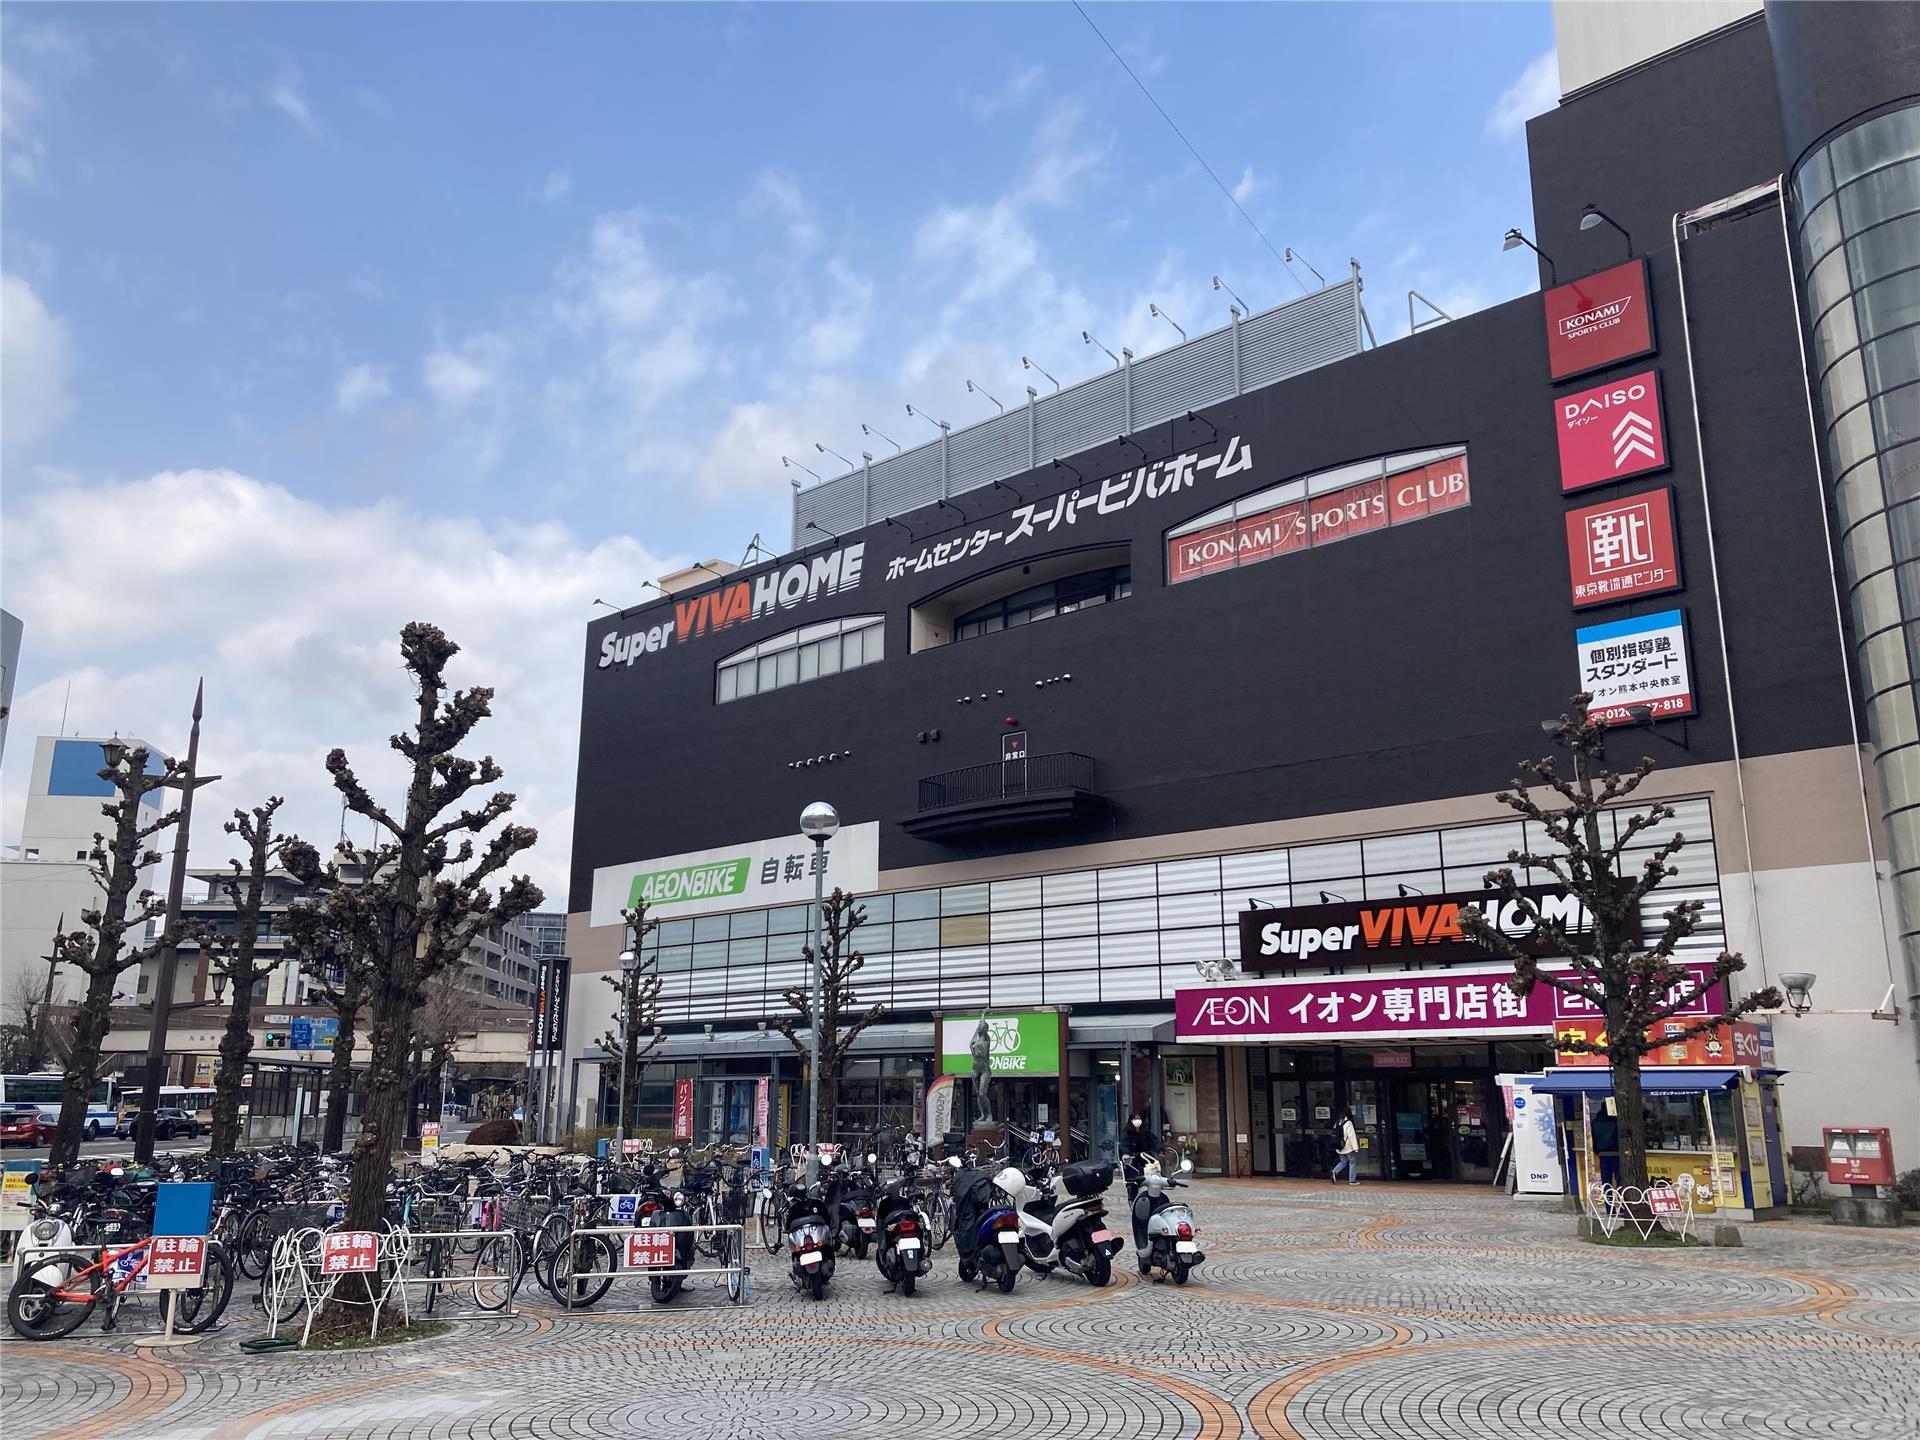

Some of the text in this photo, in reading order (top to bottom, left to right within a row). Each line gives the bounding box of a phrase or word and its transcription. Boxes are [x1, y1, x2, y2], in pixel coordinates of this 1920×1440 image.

[1567, 305, 1619, 329] KONAMI
[1568, 318, 1621, 340] SPORTS CLUB
[1565, 385, 1645, 419] DAISO
[1567, 416, 1598, 428] ダイソー
[886, 436, 1253, 581] ホームセンター スーパービバホーム
[1188, 472, 1464, 564] KONAMI SPORTS CLUB
[1592, 514, 1648, 567] 靴
[1576, 568, 1672, 598] 東京靴流通センター
[1590, 637, 1671, 664] 個別指導塾
[1587, 653, 1678, 682] スタンダード
[642, 850, 831, 900] AEONBIKE 自転車
[1288, 983, 1528, 1024] イオン専門店街
[989, 1056, 1027, 1070] ONBIKE
[678, 1084, 688, 1137] パンク修理
[935, 1091, 946, 1139] AEONBIKE
[1655, 1202, 1681, 1212] 禁止
[156, 1238, 199, 1254] 駐輪
[331, 1234, 372, 1249] 駐輪
[633, 1233, 669, 1247] 駐輪
[154, 1257, 197, 1273] 禁止
[328, 1254, 371, 1270] 禁止
[633, 1251, 669, 1265] 禁止
